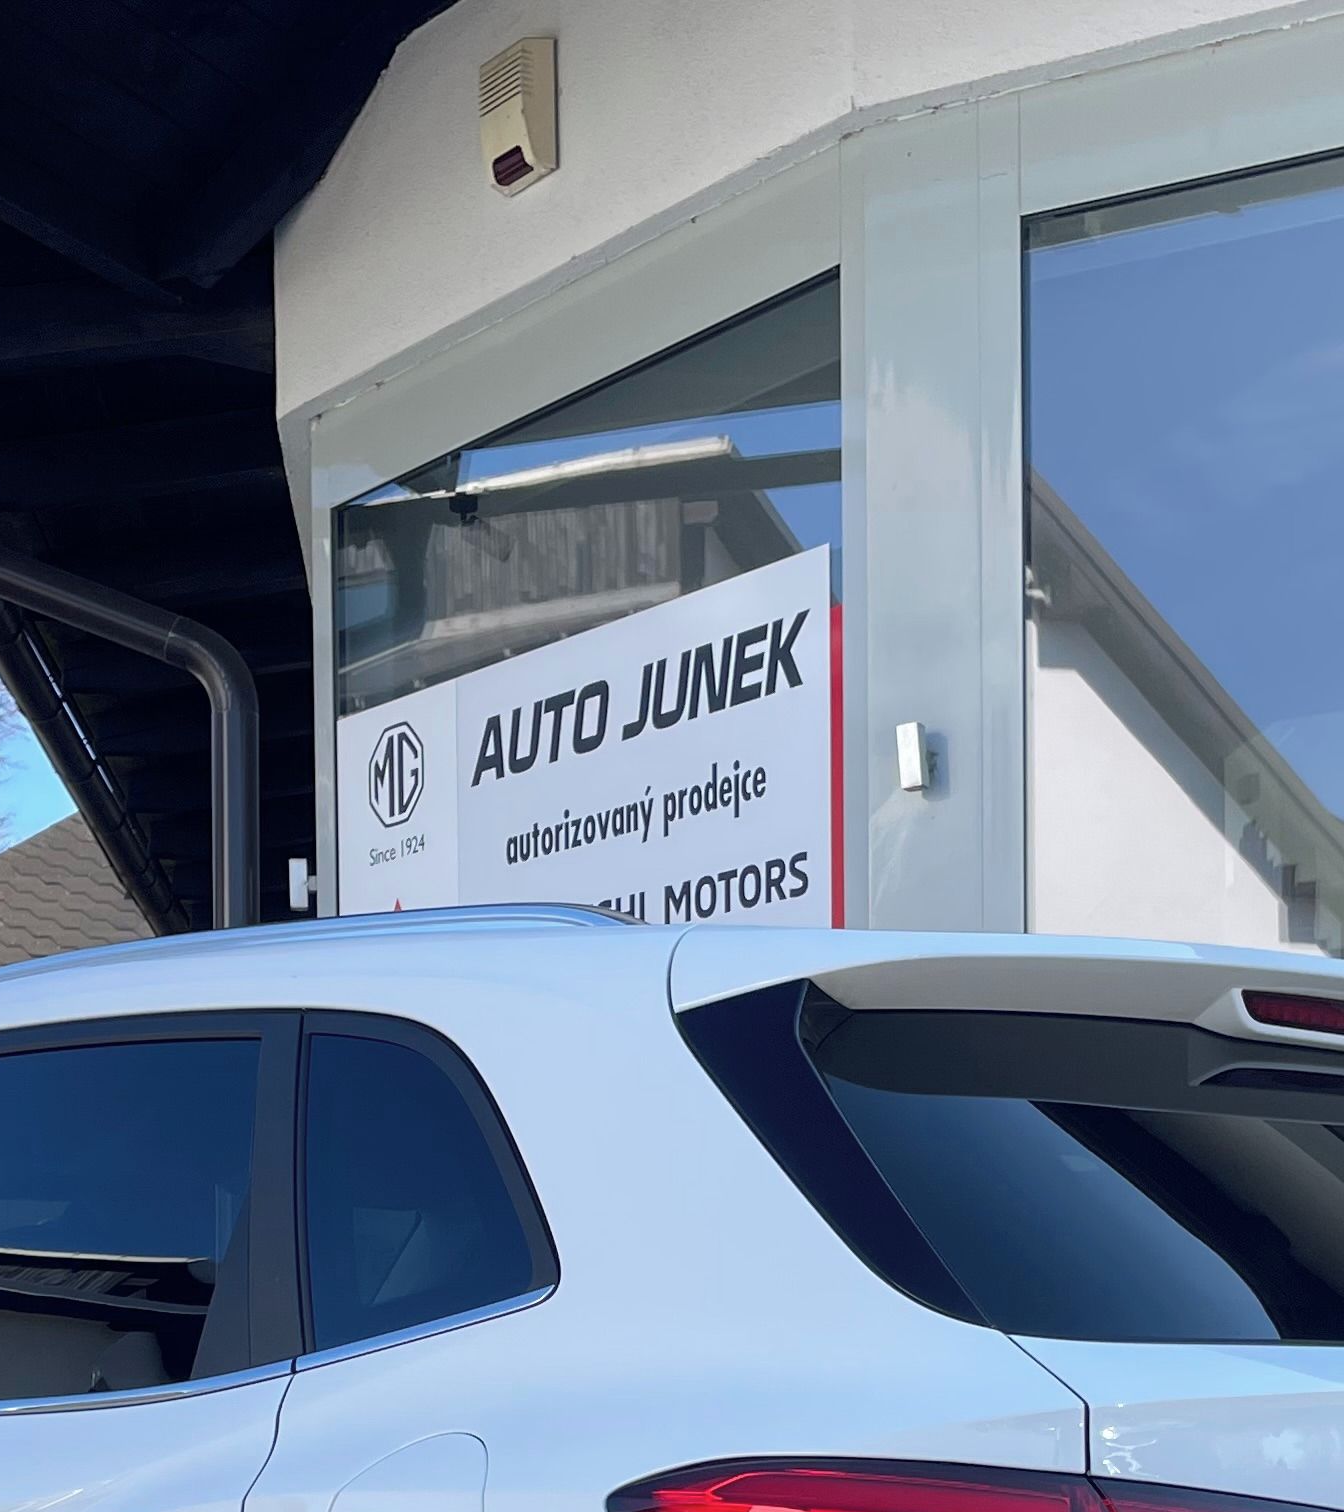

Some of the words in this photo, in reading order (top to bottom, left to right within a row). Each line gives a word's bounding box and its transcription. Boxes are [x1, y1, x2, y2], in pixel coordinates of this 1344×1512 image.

[471, 679, 610, 788] AUTO
[621, 608, 811, 741] JUNEK
[371, 726, 422, 822] MG
[506, 785, 654, 865] autorizovaný
[662, 760, 767, 837] prodejce
[369, 846, 397, 867] Since
[400, 833, 425, 859] 1924
[664, 851, 809, 924] MOTORS
